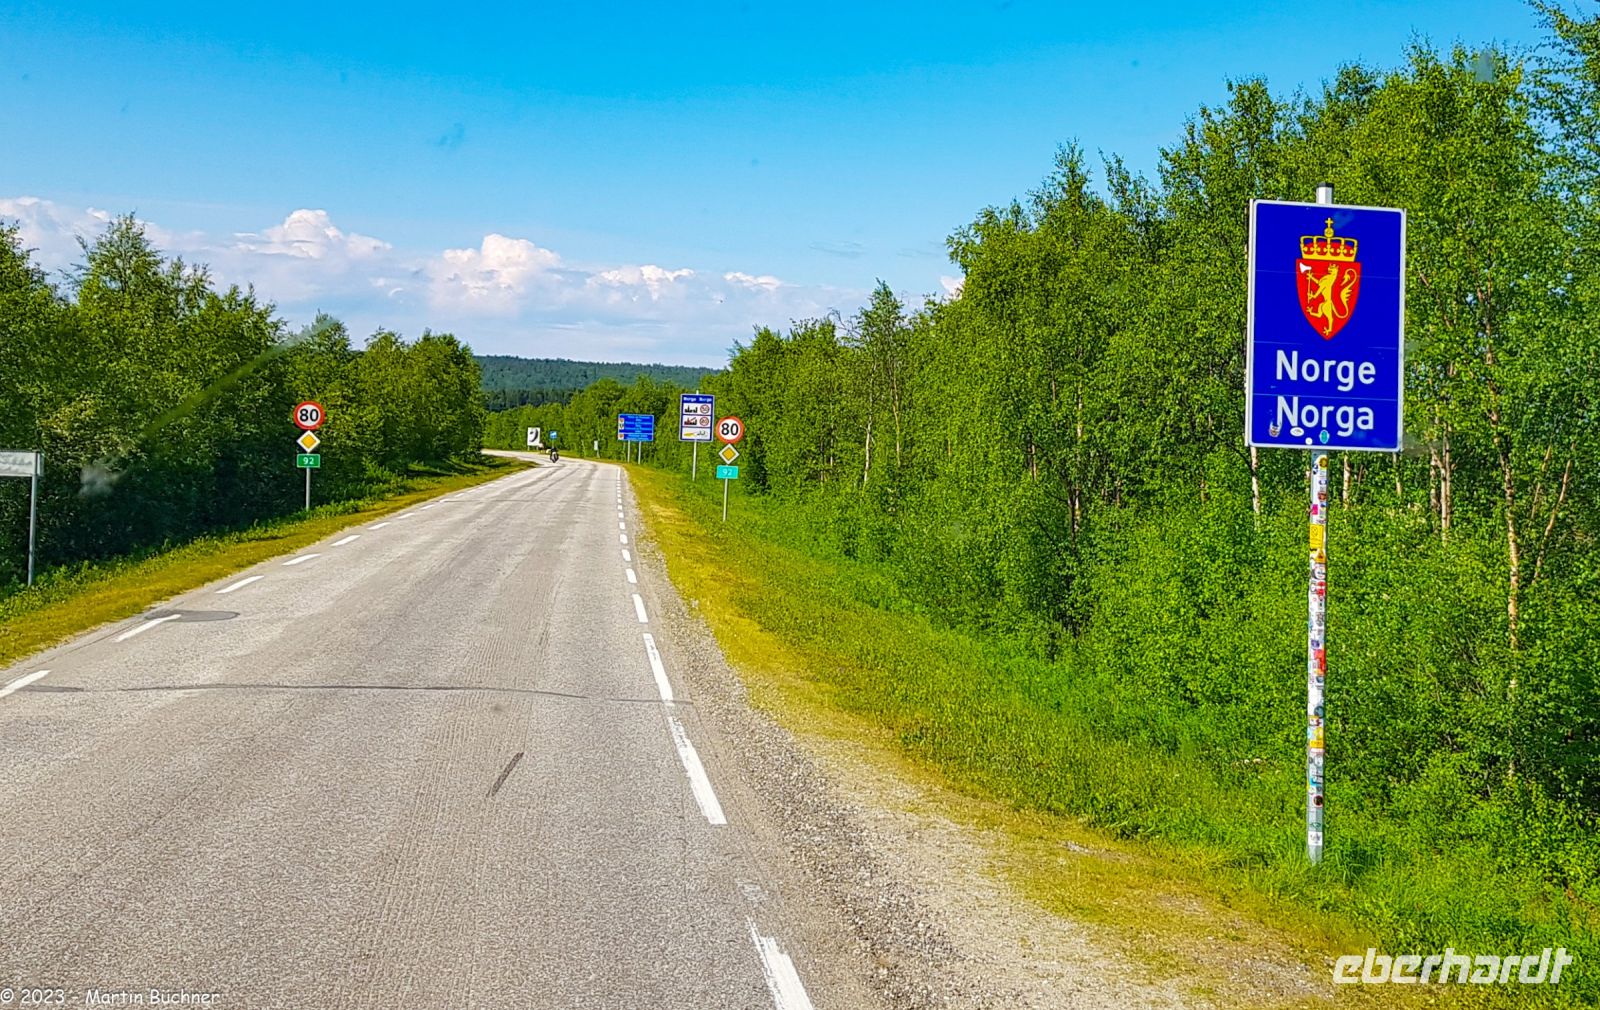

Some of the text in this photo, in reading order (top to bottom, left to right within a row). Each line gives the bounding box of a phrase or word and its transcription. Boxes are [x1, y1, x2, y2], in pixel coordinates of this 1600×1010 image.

[1276, 350, 1376, 391] Norge
[299, 408, 320, 422] 80
[1277, 396, 1374, 437] Norga
[721, 423, 739, 436] 80
[303, 457, 315, 465] 92
[722, 468, 733, 476] 92
